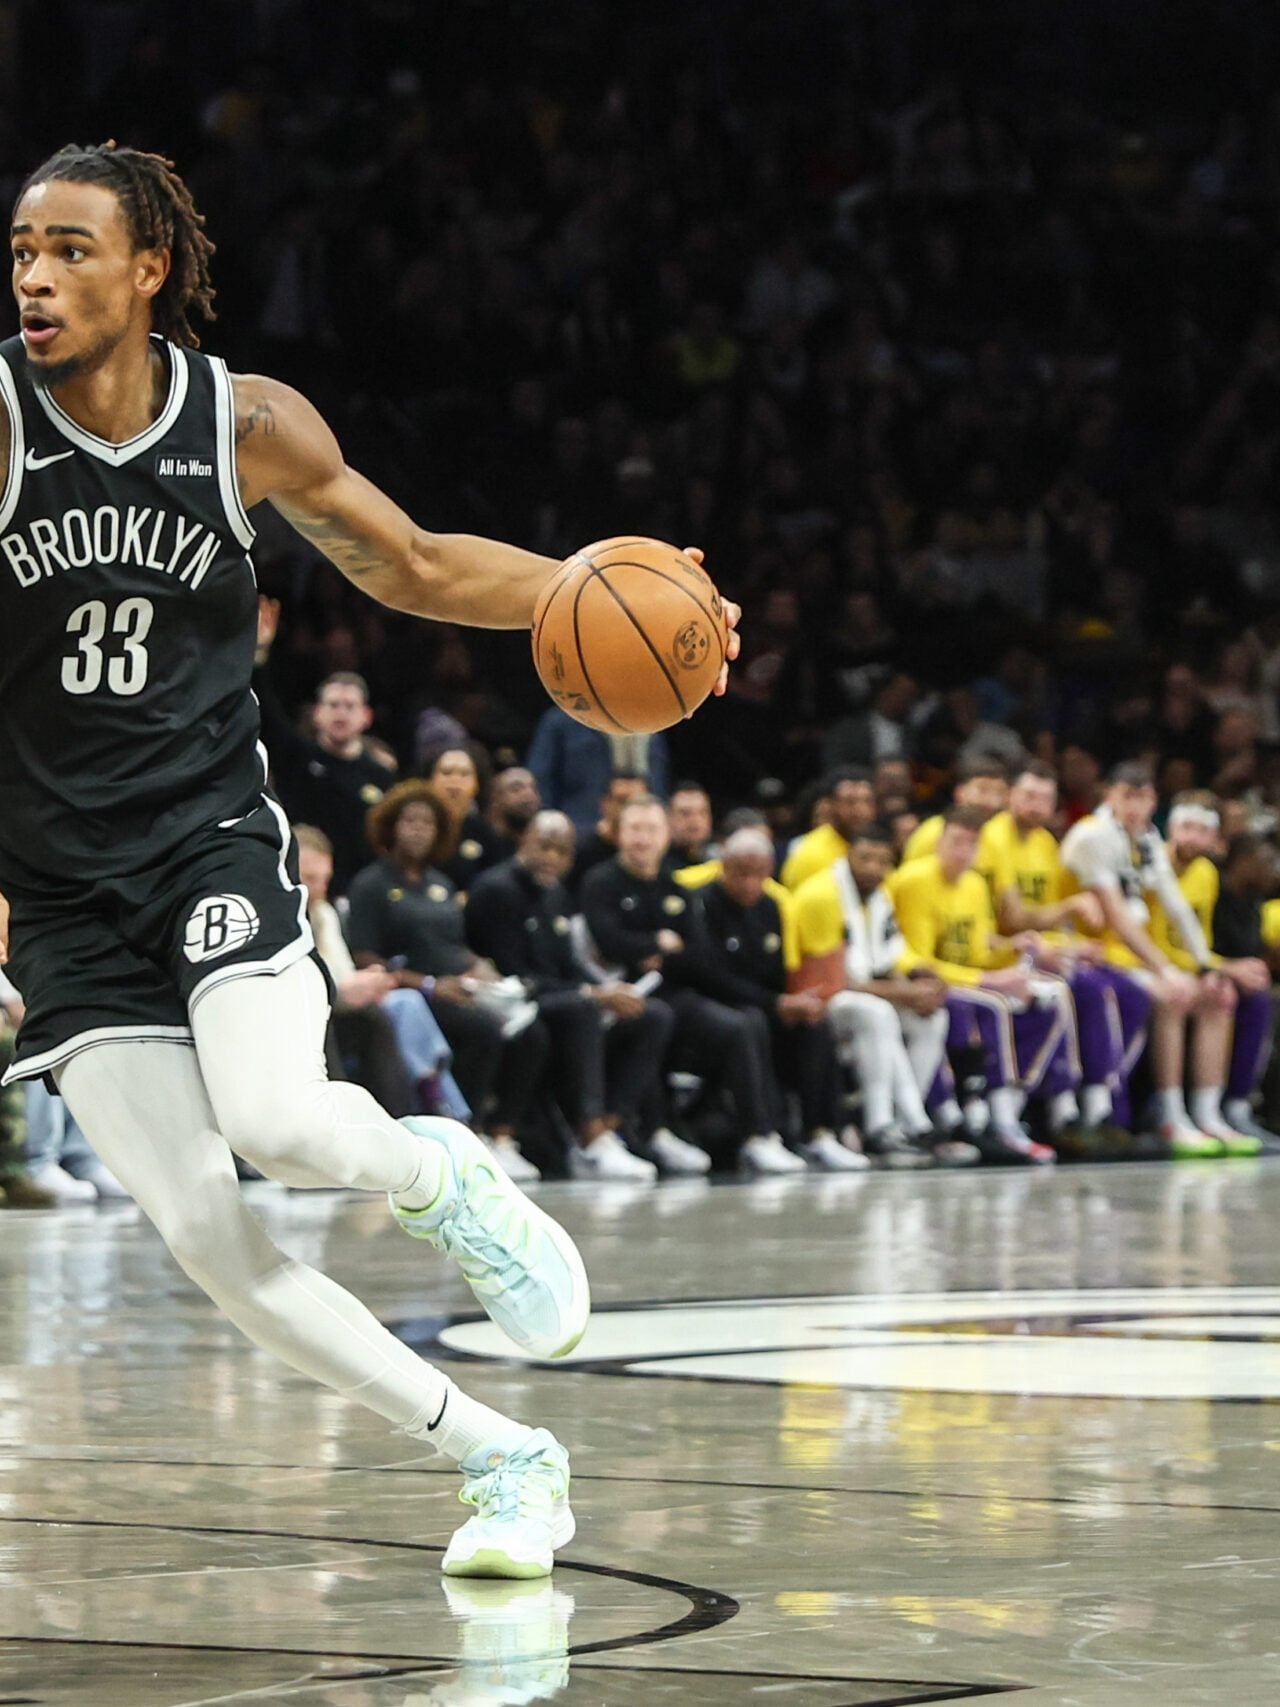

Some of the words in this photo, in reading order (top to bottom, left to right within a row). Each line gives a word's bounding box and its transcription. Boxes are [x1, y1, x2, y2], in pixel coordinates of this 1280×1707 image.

[159, 459, 174, 476] All
[176, 459, 187, 476] In
[189, 459, 212, 476] Won
[0, 505, 221, 590] BROOKLYN
[61, 597, 154, 695] 33
[203, 904, 228, 953] B
